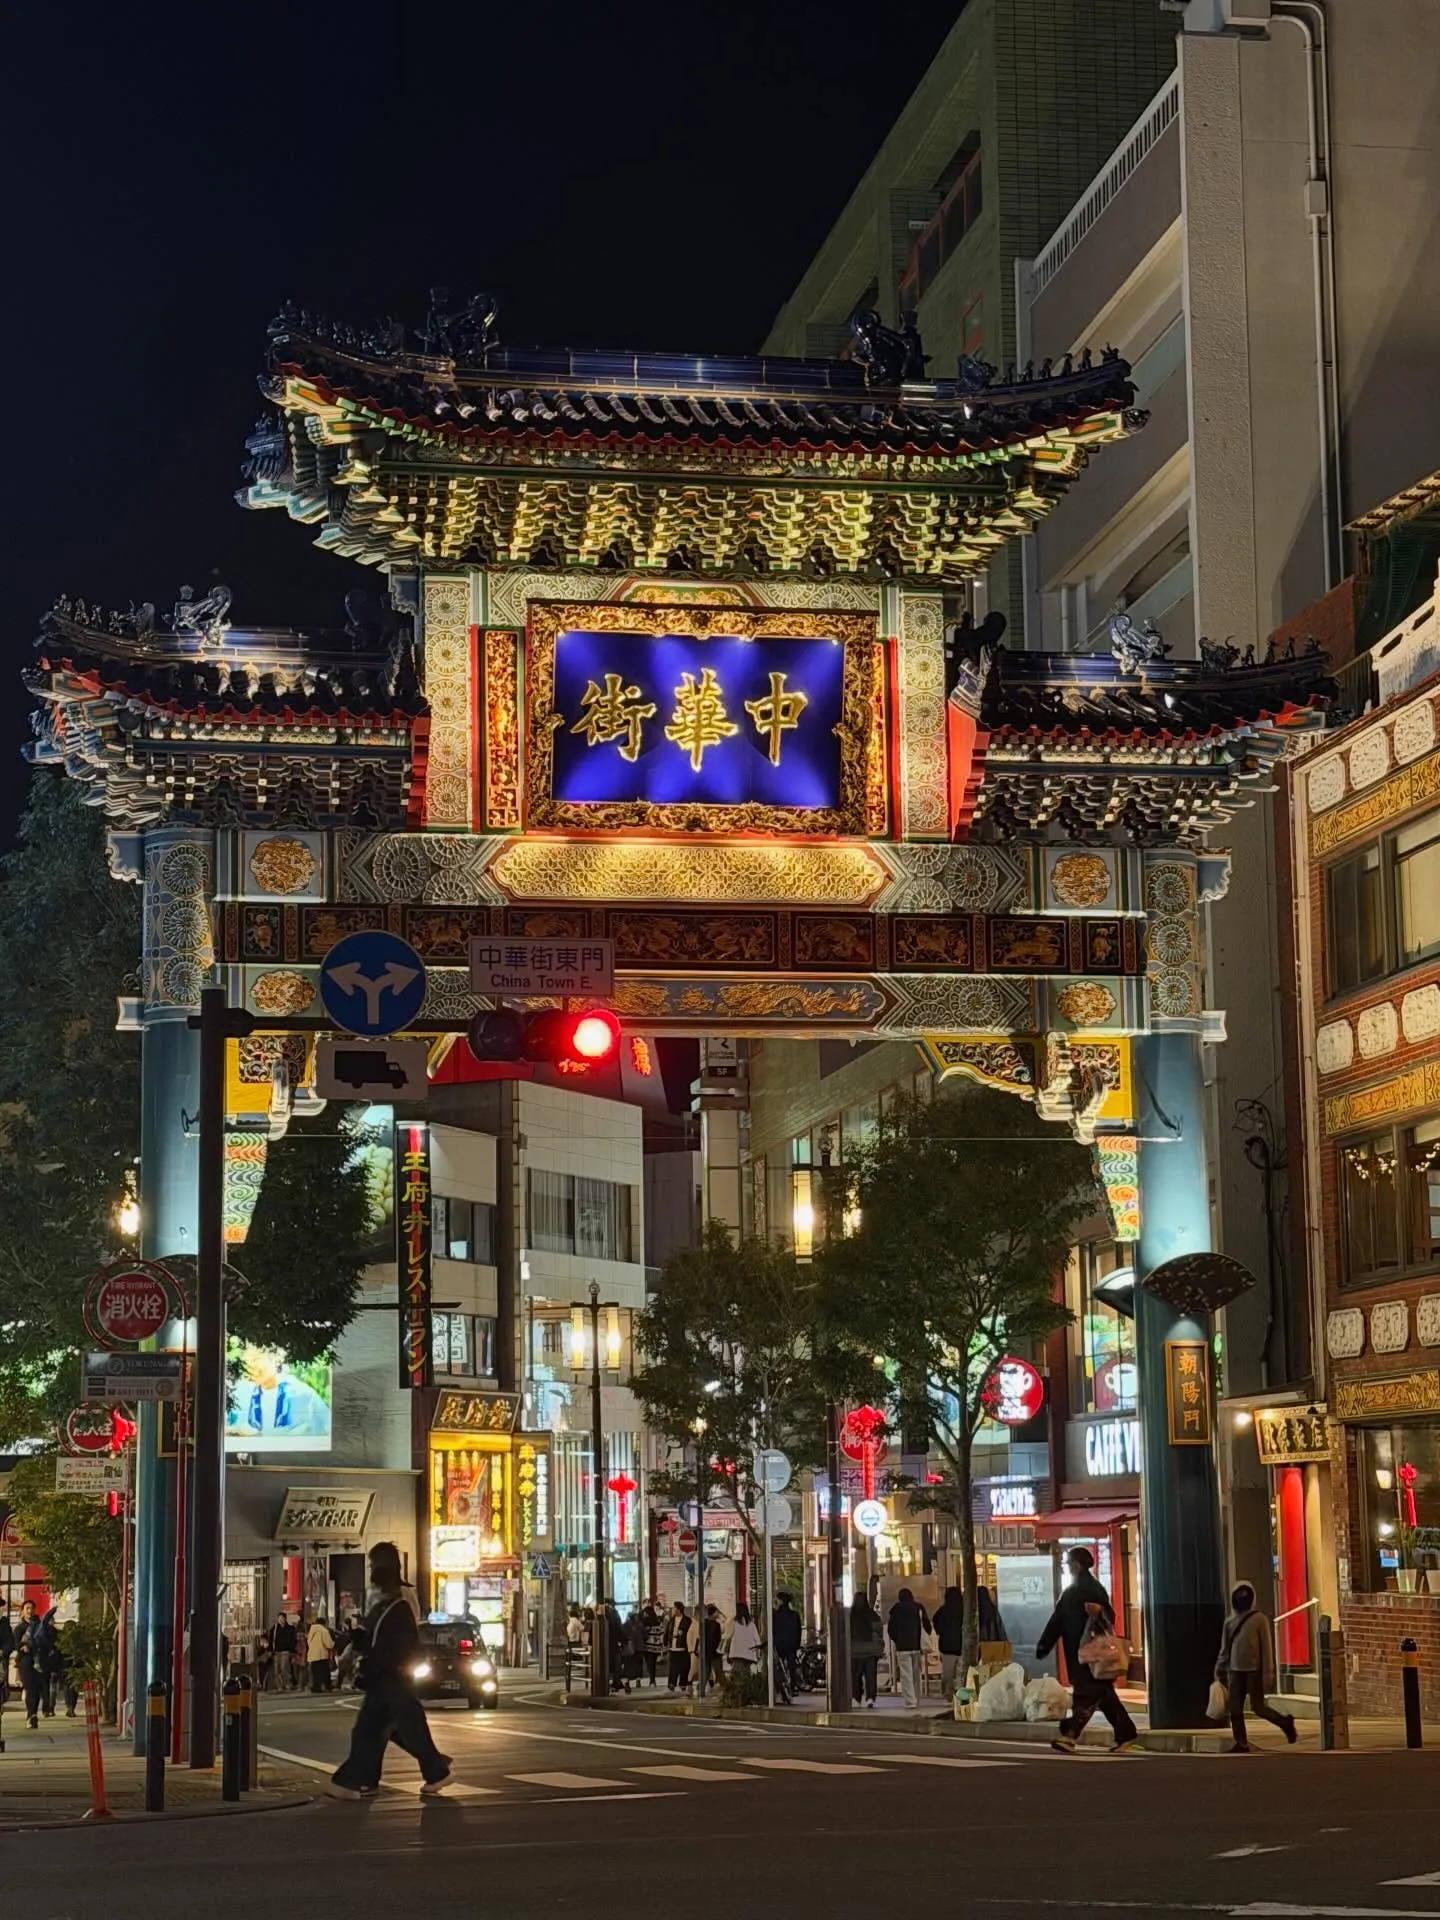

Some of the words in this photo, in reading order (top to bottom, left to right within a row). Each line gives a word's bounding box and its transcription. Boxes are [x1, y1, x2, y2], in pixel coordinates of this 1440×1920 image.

[479, 945, 604, 972] 中華街東門
[490, 974, 531, 988] China
[537, 975, 575, 989] Town
[580, 976, 593, 989] E.
[401, 1151, 430, 1373] 王府井レストラン
[104, 1293, 161, 1320] 消火栓
[1178, 1351, 1201, 1431] 朝陽門
